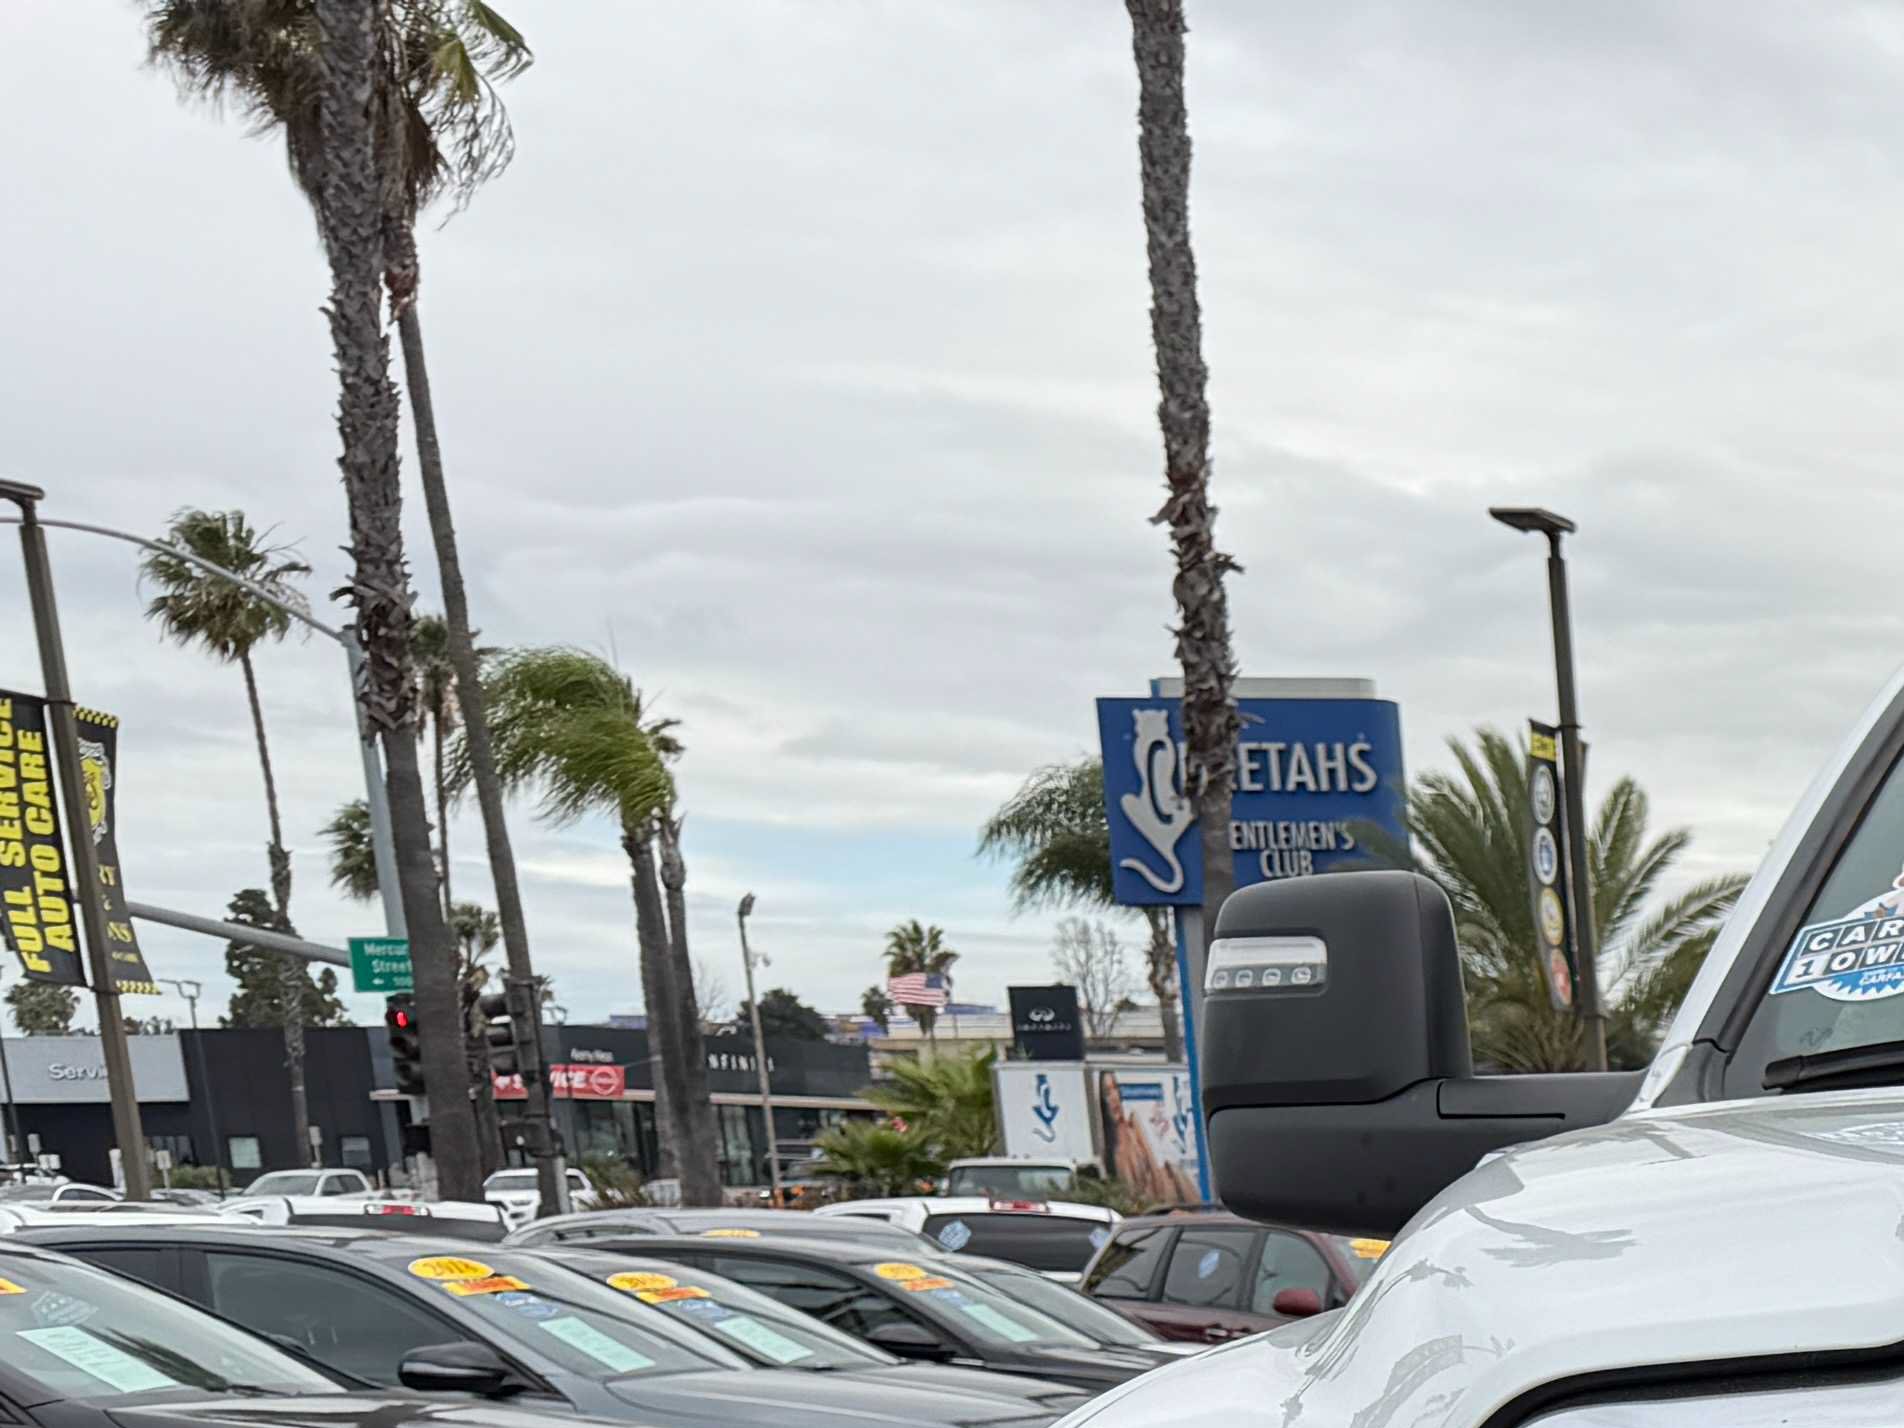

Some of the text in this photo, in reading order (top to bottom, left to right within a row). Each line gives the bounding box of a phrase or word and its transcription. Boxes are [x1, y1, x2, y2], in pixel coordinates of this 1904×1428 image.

[17, 729, 75, 952] AUTO CARE
[1229, 819, 1356, 851] ENTLEMEN'S
[1260, 849, 1314, 878] CLUB
[4, 884, 51, 972] FULL
[1794, 956, 1820, 979] 1
[49, 1064, 109, 1081] Servi
[708, 1053, 775, 1072] NFINII
